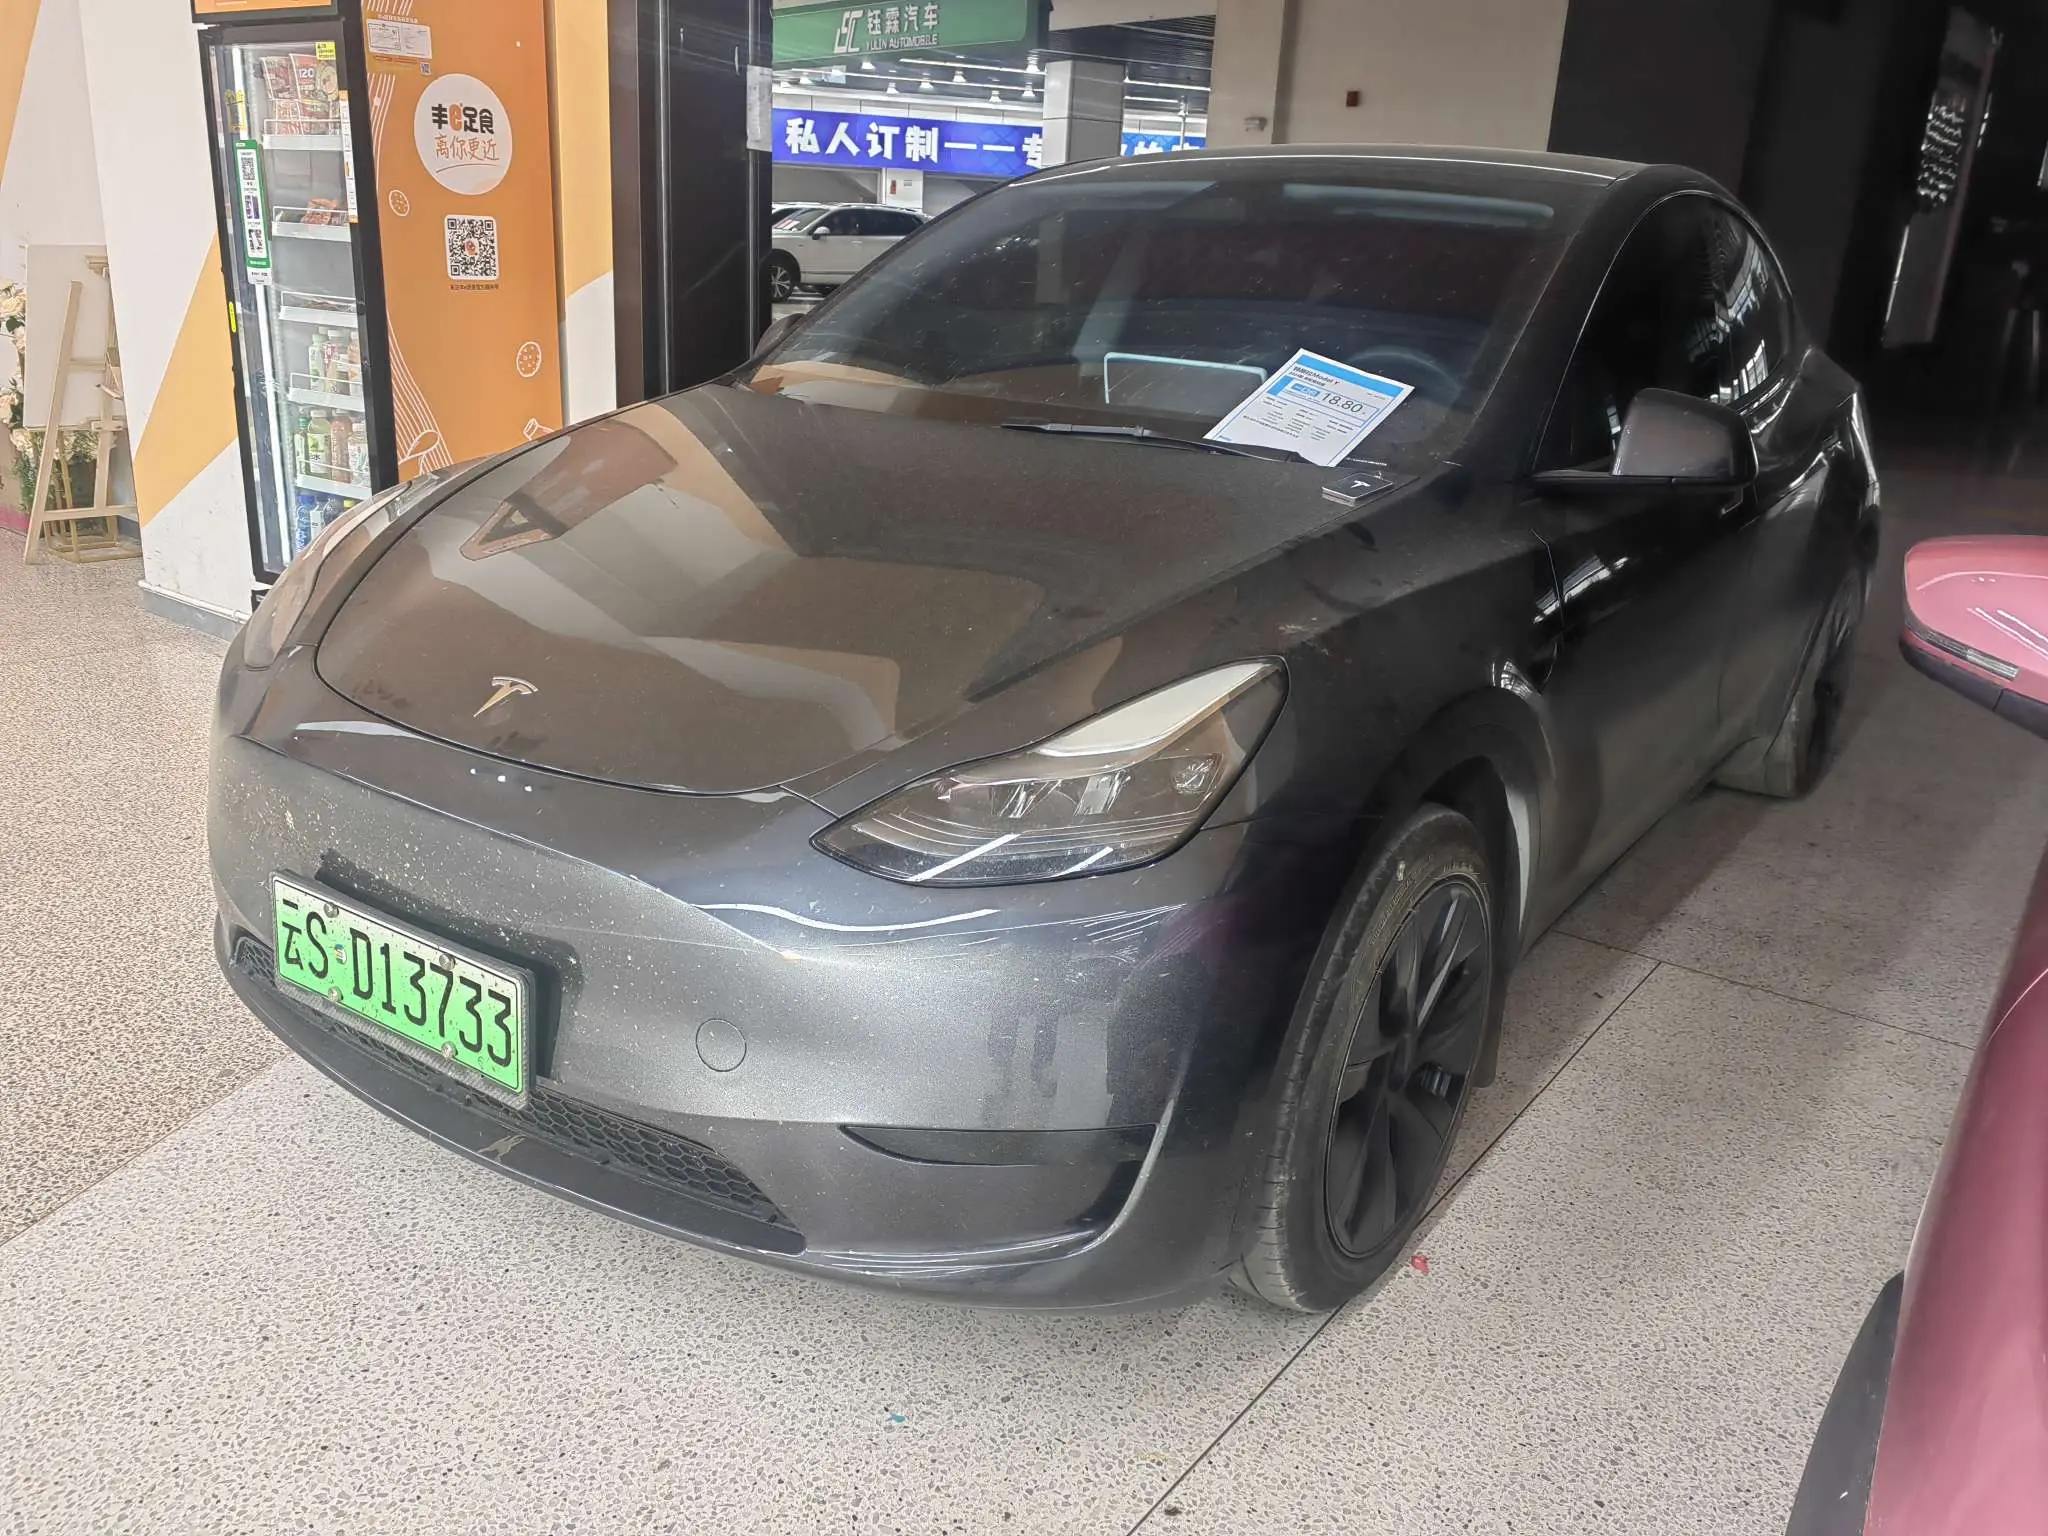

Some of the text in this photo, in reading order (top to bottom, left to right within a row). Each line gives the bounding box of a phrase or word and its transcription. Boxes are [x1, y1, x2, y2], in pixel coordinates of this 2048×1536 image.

[867, 2, 938, 35] 钰霖汽车
[866, 33, 938, 51] YULIN AUTOMOBILE
[431, 103, 495, 134] 丰e足食
[435, 133, 500, 161] 离你更近
[1321, 391, 1363, 413] 18.80
